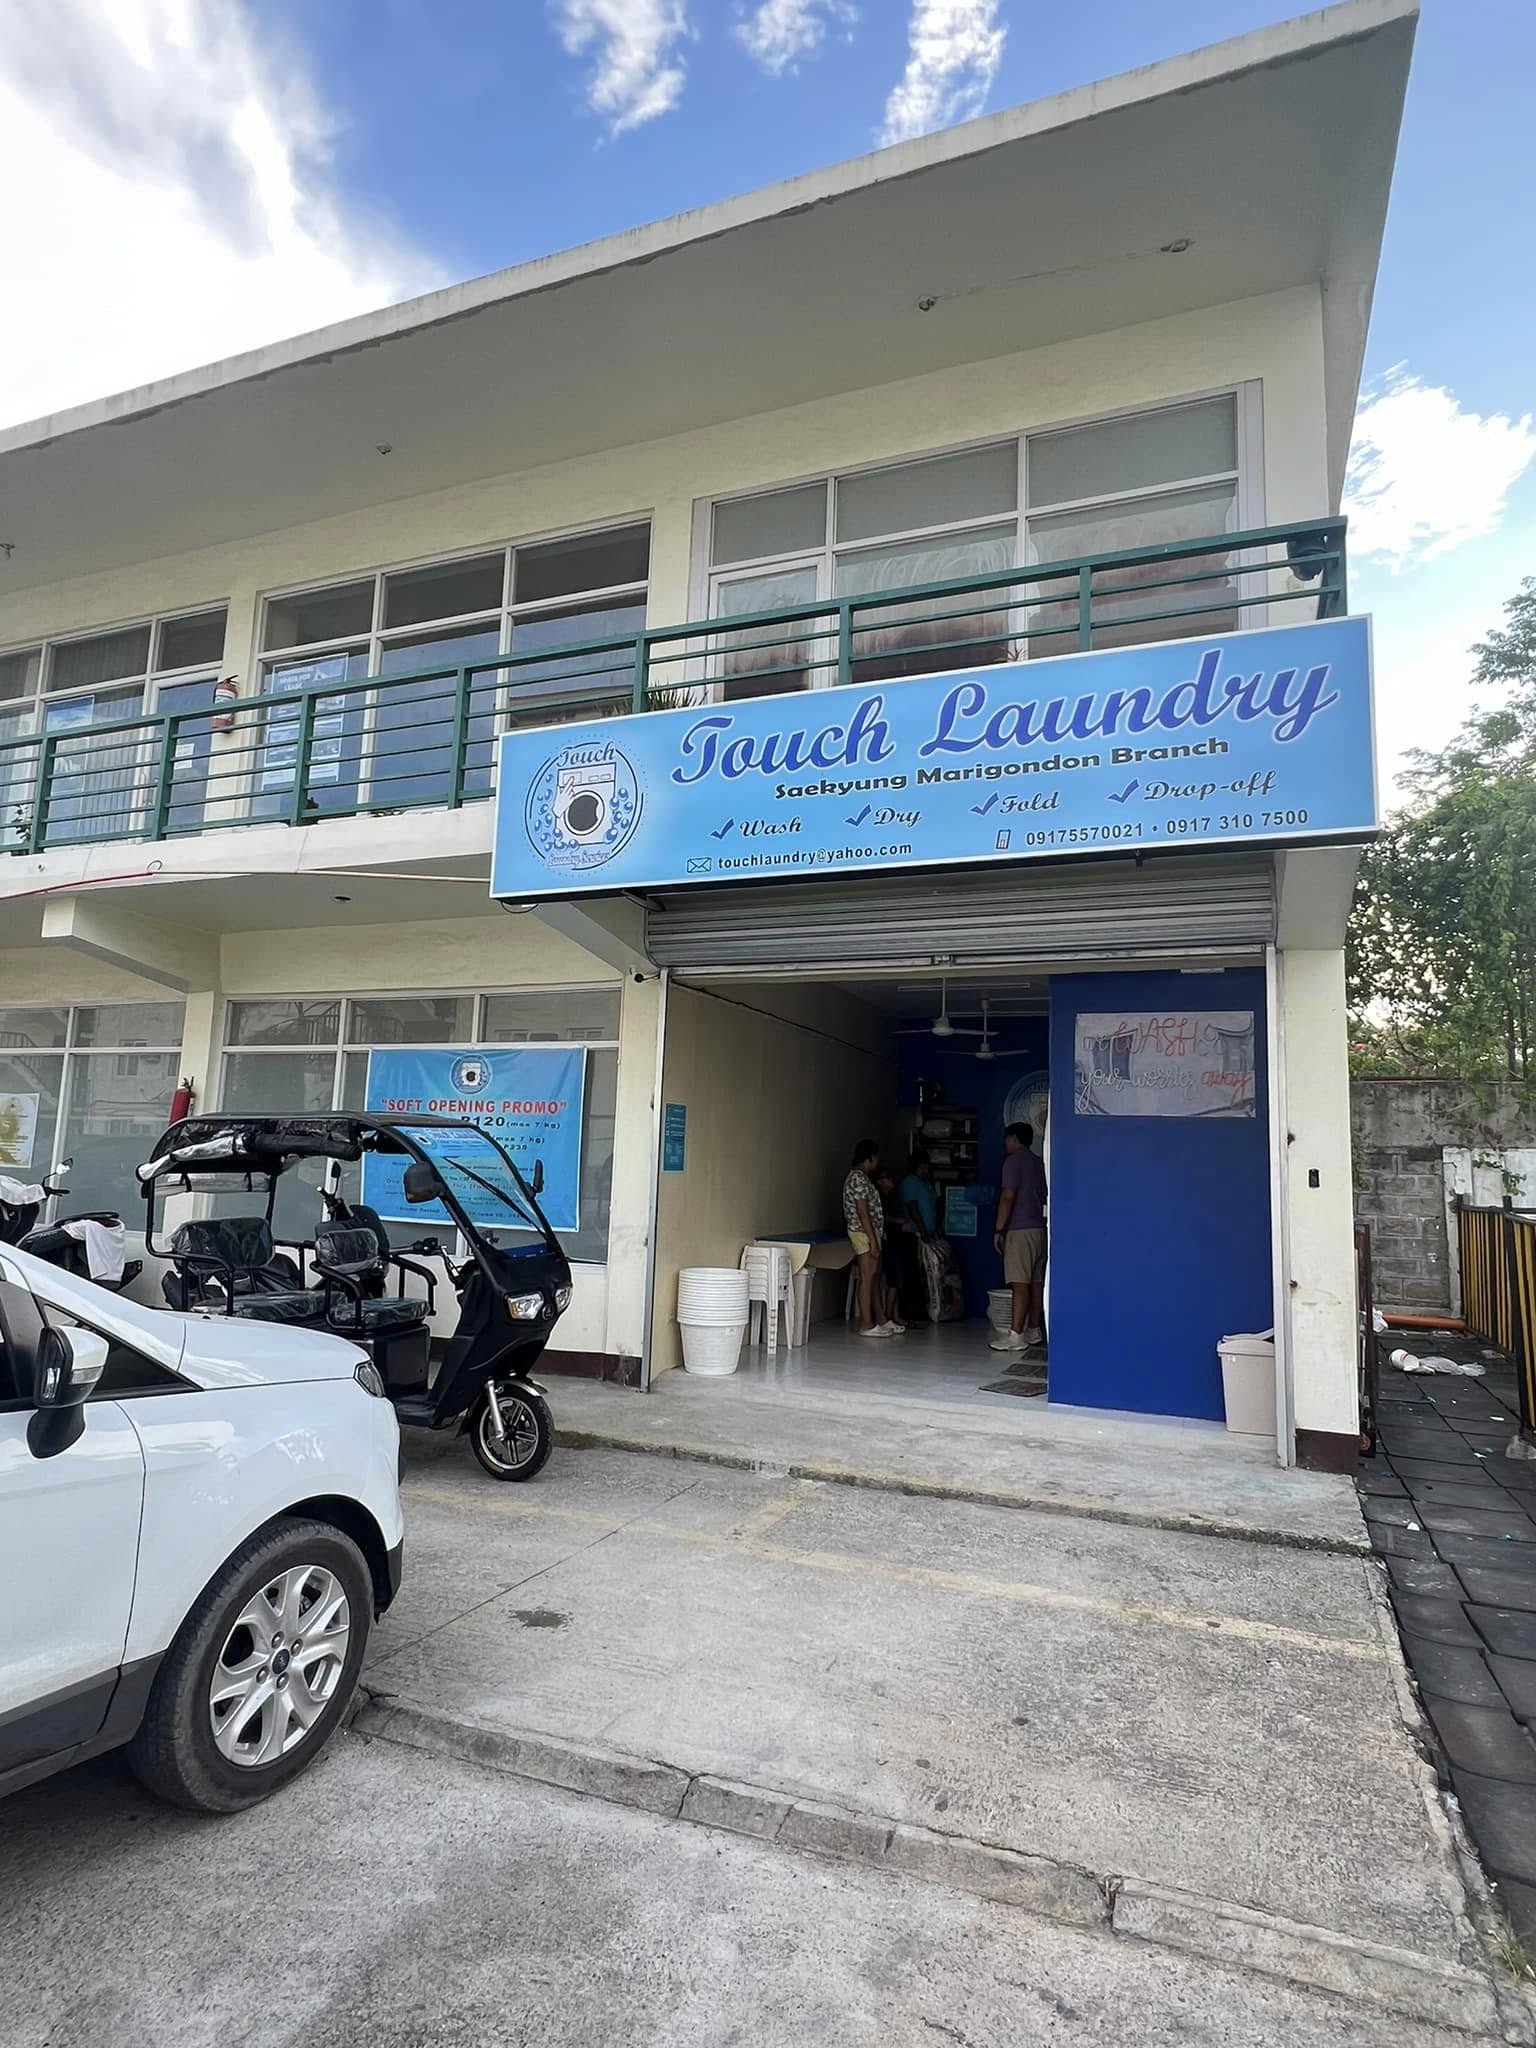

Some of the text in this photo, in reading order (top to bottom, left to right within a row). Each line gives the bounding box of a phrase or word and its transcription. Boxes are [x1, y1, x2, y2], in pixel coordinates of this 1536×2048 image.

[671, 648, 1339, 784] Touch Laundry
[556, 741, 615, 767] Touch
[775, 738, 1229, 799] Saekyung Marigondon Branch
[1143, 770, 1278, 801] Drop-off
[999, 791, 1060, 814] Fold
[739, 815, 803, 837] Wash
[873, 806, 922, 828] Dry
[1026, 809, 1309, 846] 09175570021 0917 310 7500
[718, 843, 913, 869] touchlaundry@yahoo.com
[428, 1100, 496, 1113] OPENING
